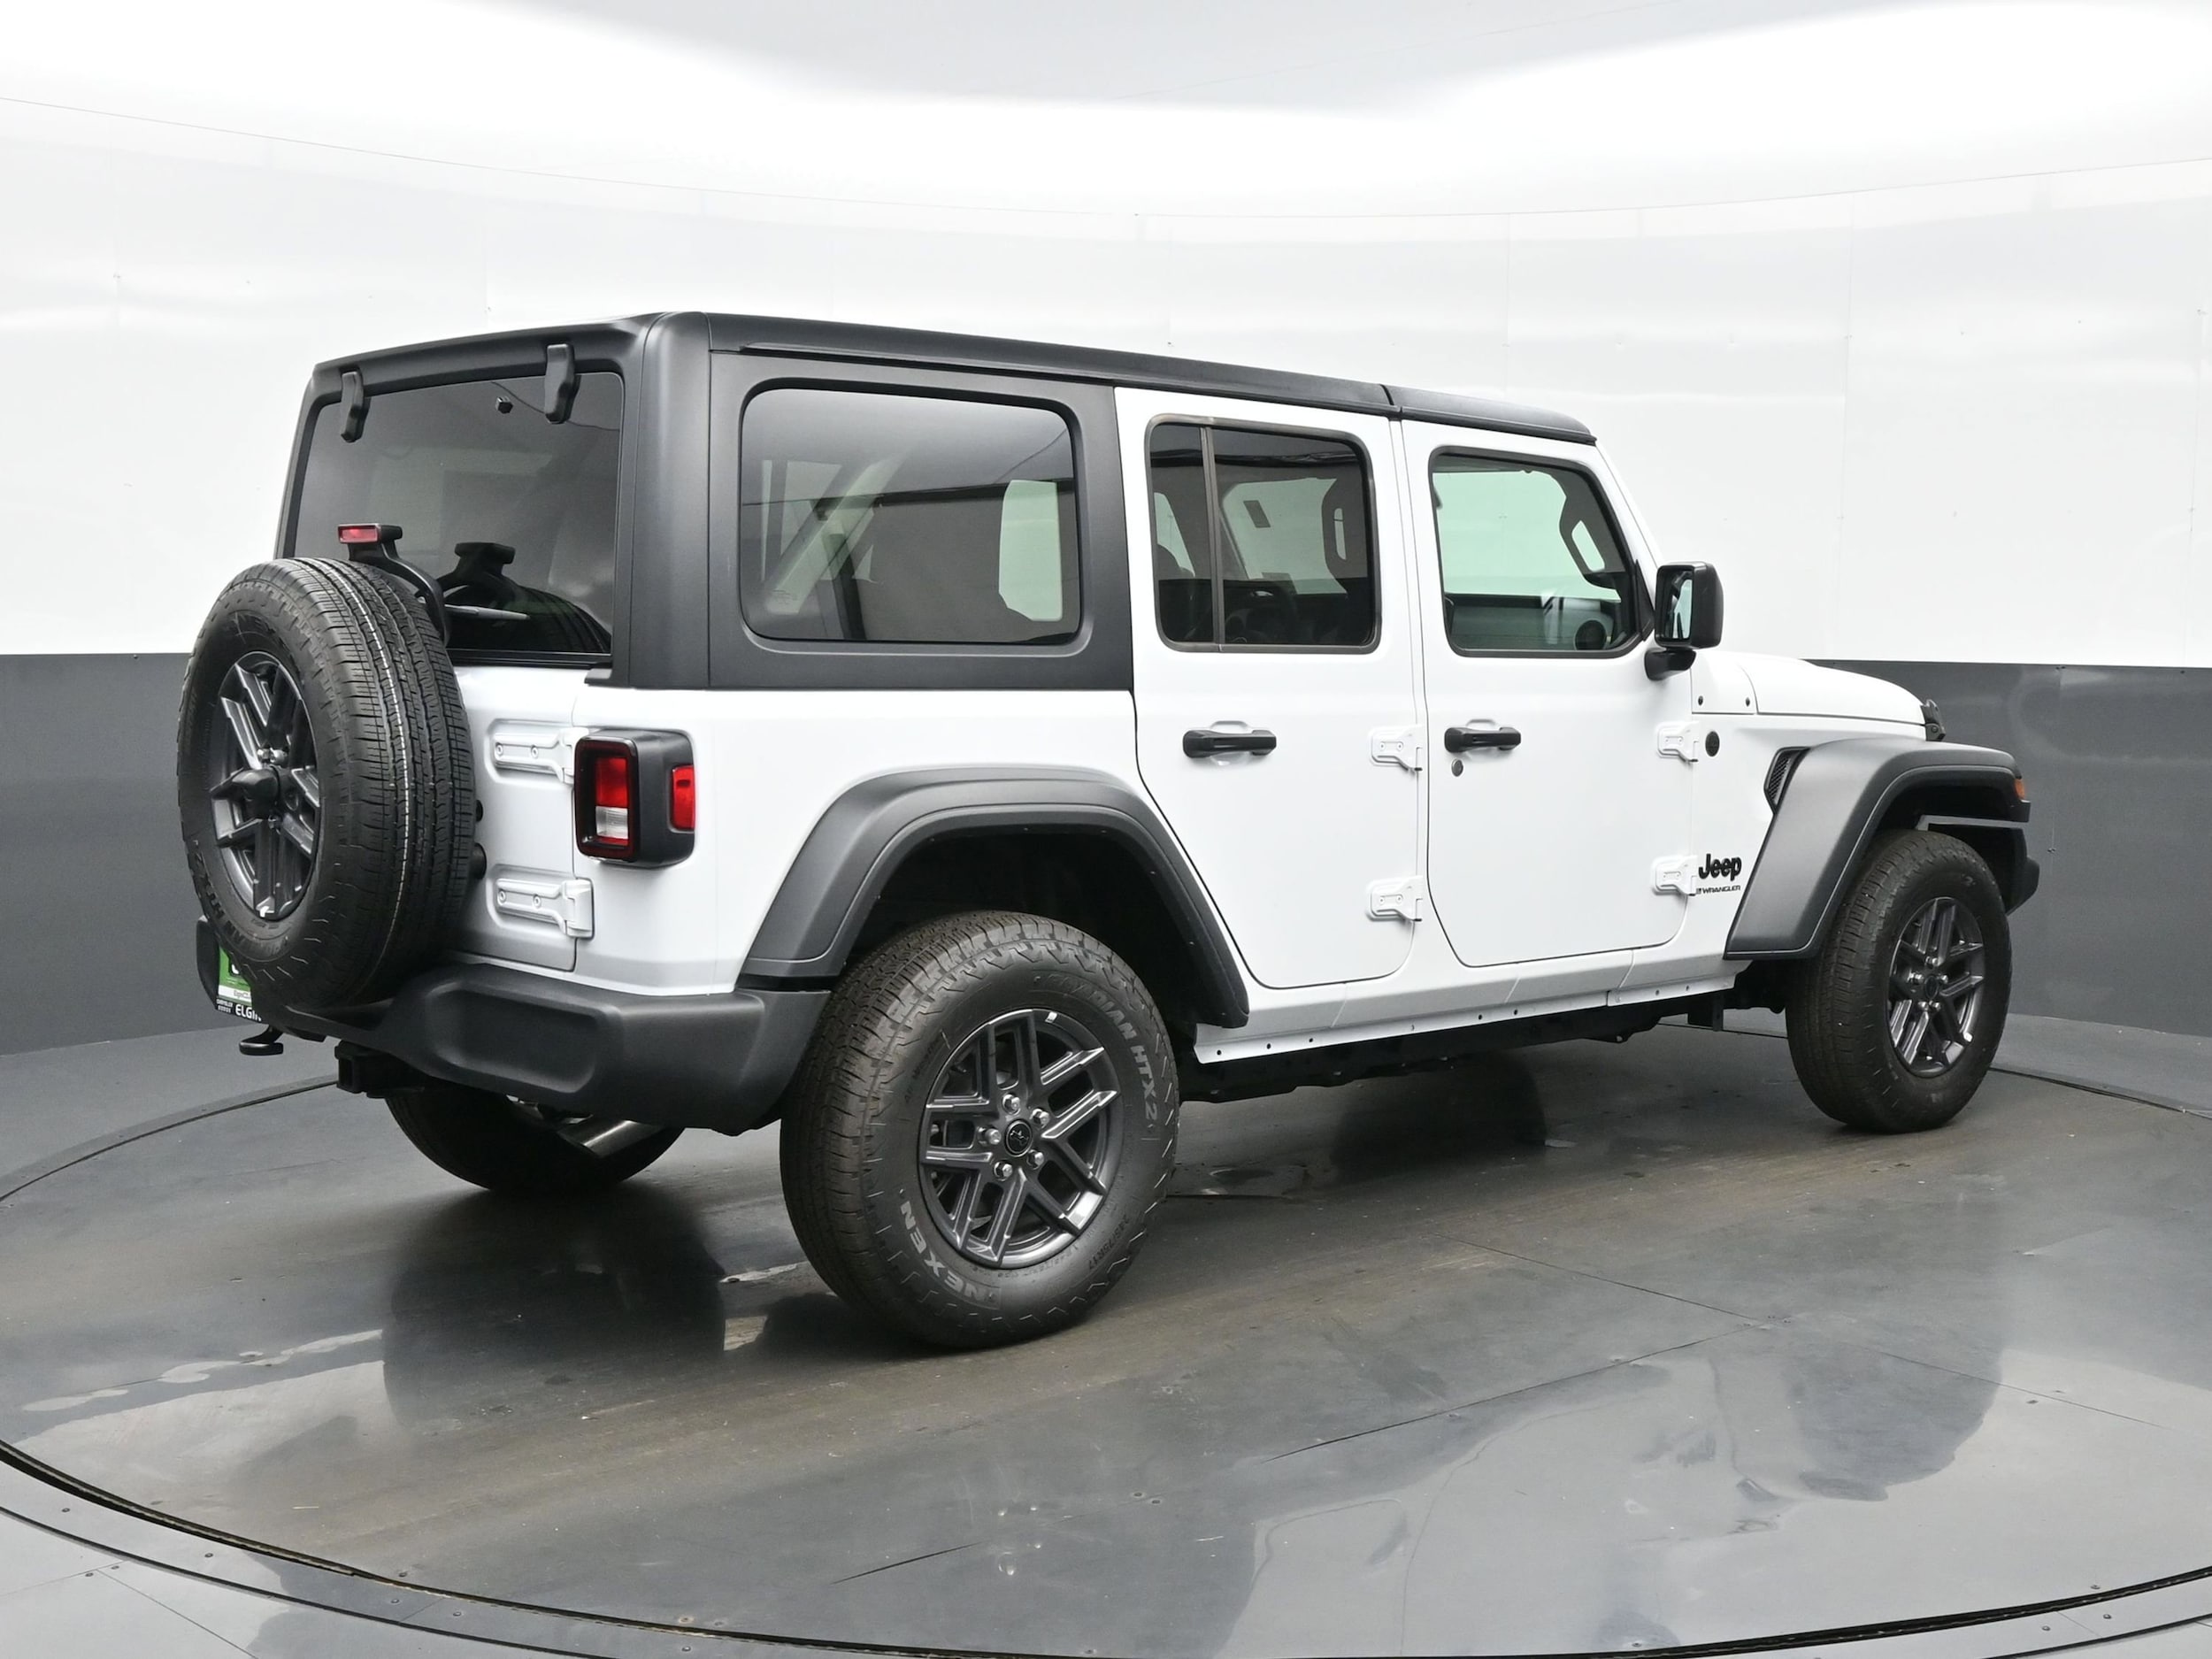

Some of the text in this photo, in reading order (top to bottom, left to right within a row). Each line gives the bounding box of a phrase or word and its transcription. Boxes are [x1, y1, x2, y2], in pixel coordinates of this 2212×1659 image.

[1698, 853, 1742, 881] Jeep
[1702, 885, 1741, 894] WRANGLER
[900, 1201, 985, 1301] NEXEN
